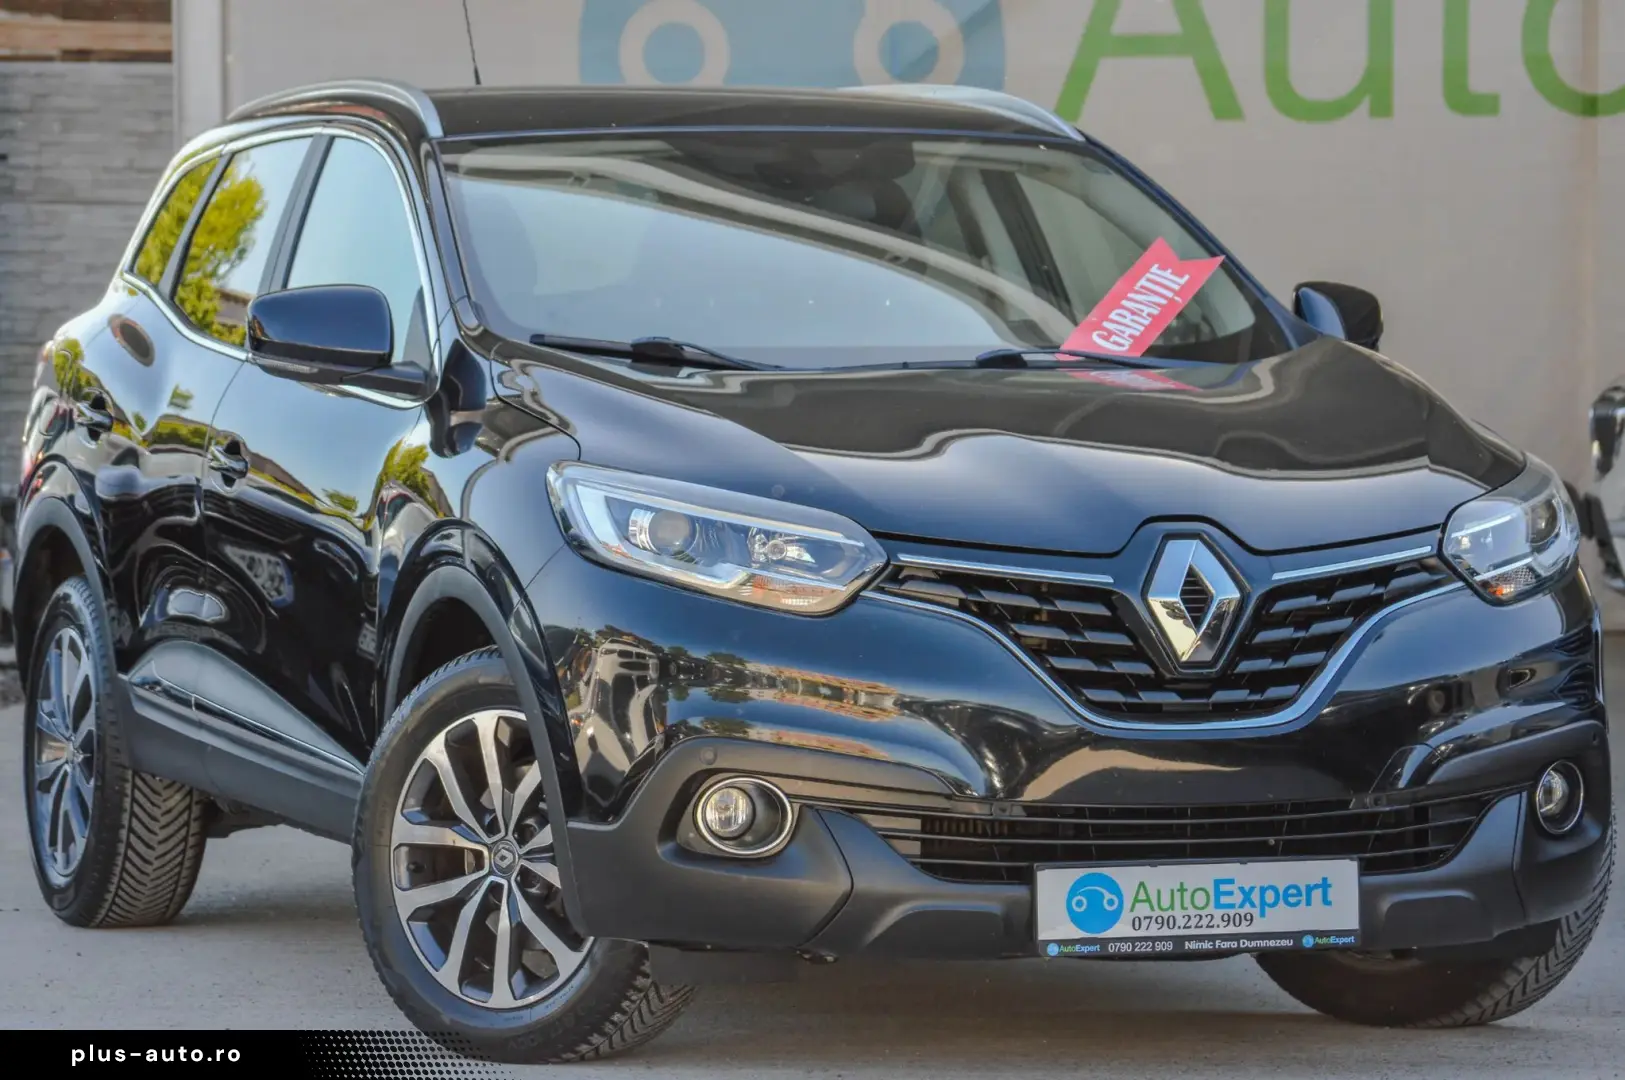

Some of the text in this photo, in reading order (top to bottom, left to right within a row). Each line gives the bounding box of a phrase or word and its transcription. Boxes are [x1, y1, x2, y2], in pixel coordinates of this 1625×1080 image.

[1129, 876, 1333, 919] AutoExpert
[1131, 912, 1255, 932] 0790.222.909
[1108, 940, 1174, 953] 0790 222 909
[1184, 937, 1294, 950] Nimic Fara Dumnezeu
[1314, 935, 1356, 945] AutoExpert
[1059, 943, 1101, 953] AutoExpert
